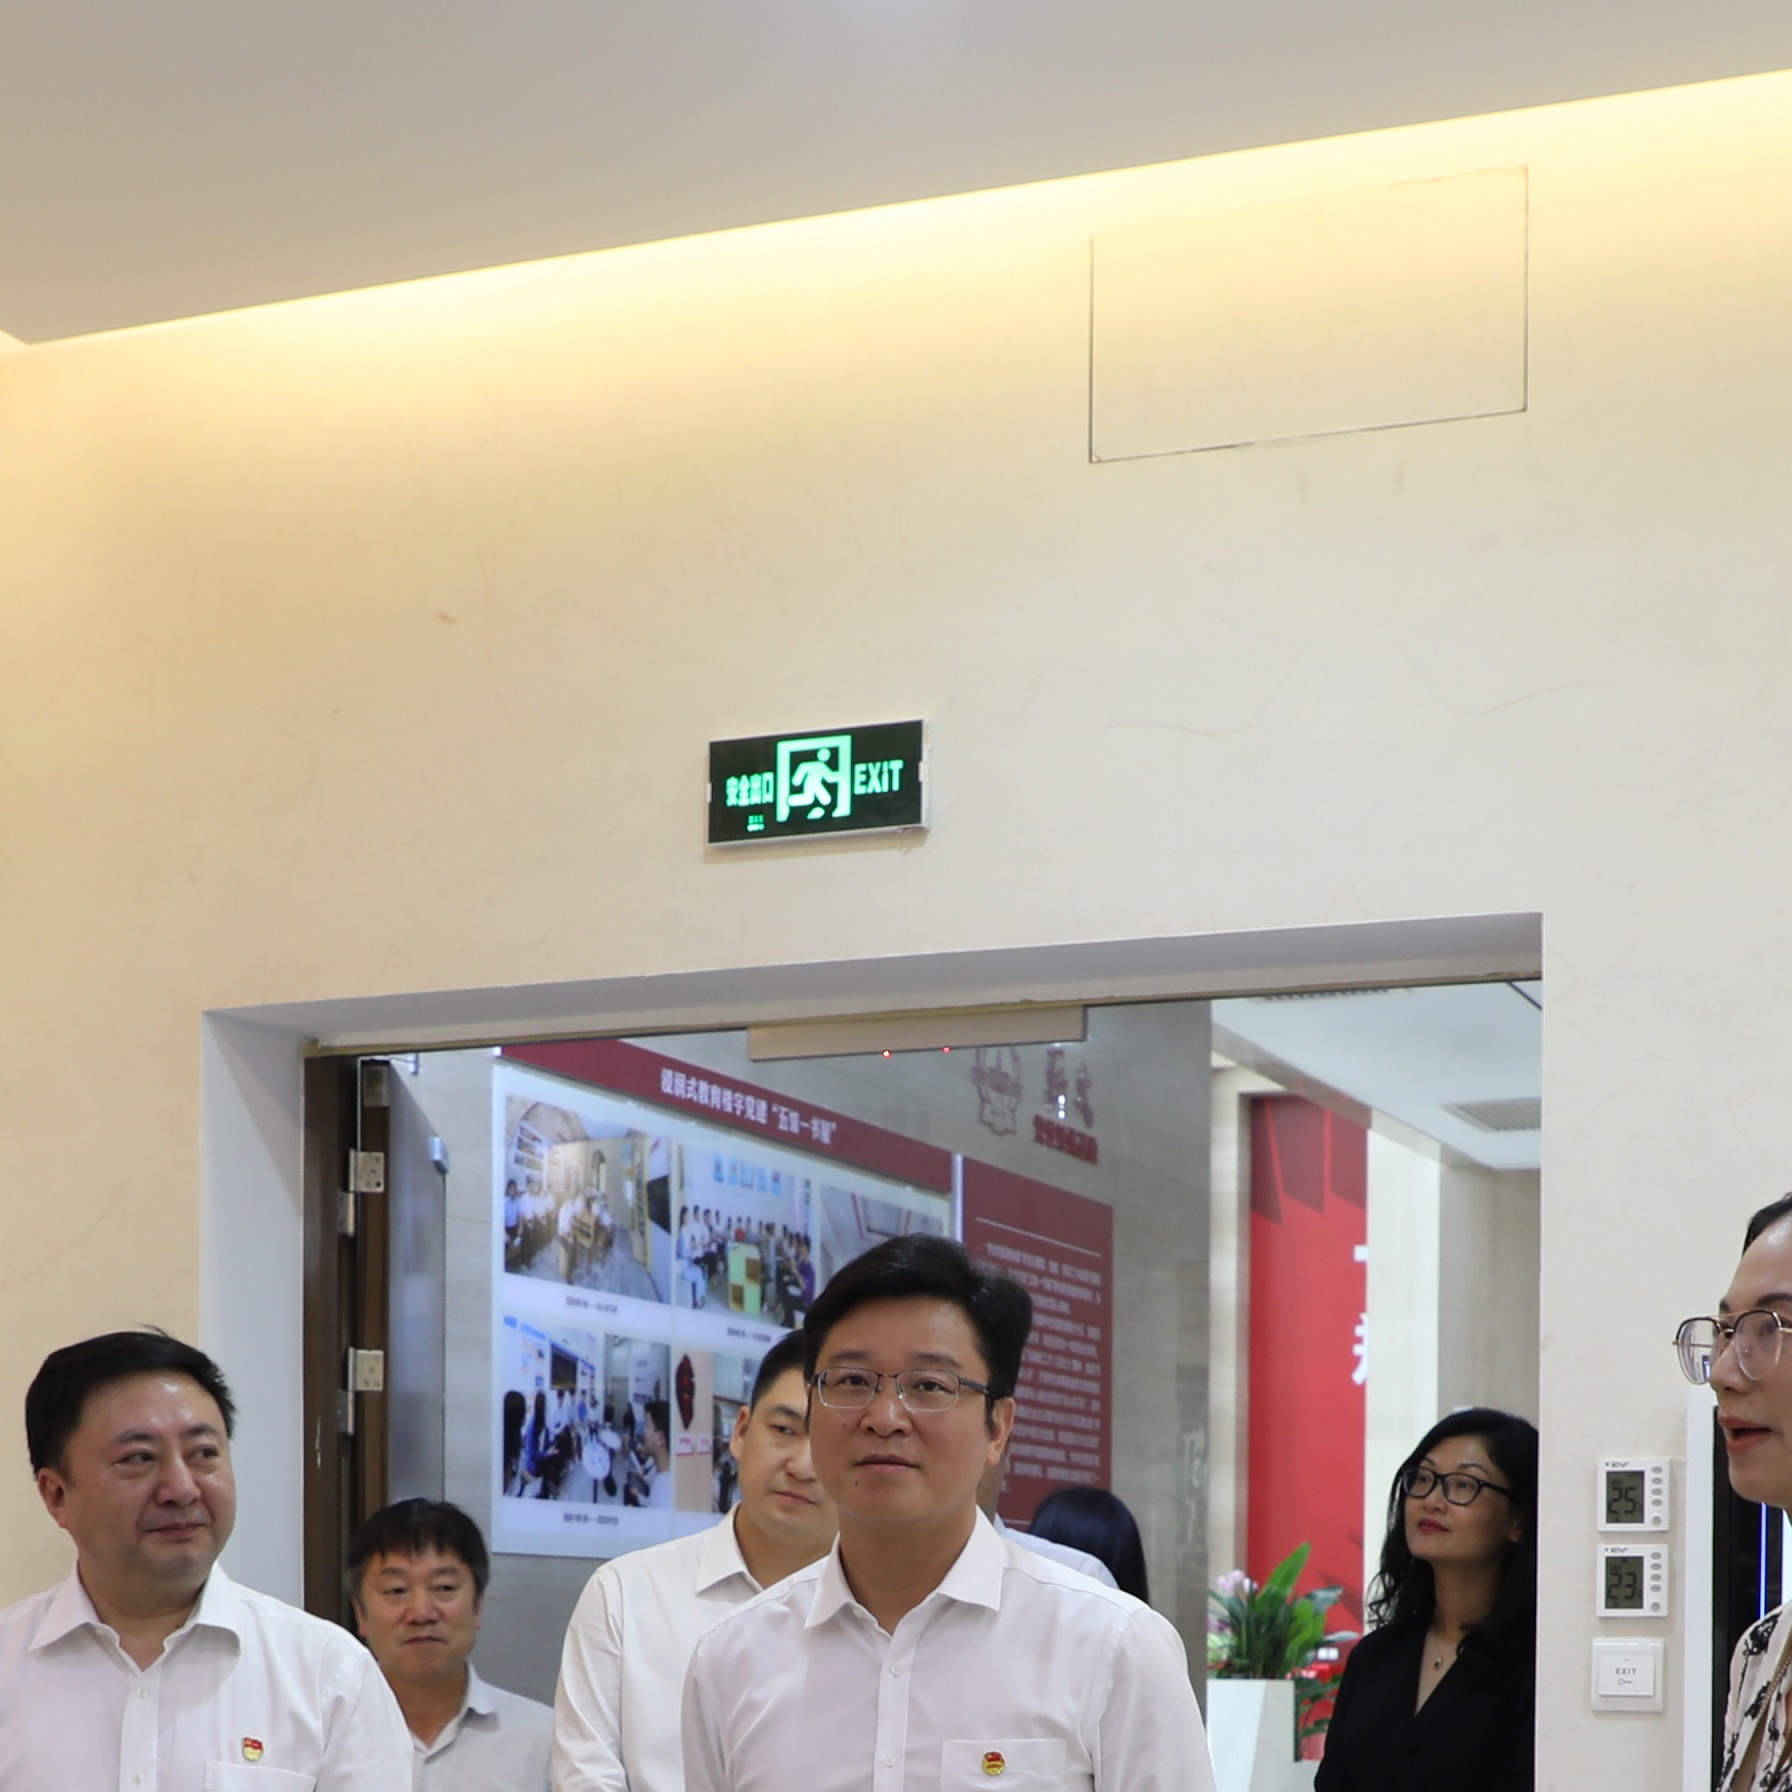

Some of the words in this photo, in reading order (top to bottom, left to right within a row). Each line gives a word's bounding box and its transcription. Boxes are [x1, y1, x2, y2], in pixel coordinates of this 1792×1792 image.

[725, 771, 774, 807] 安全出口
[854, 759, 904, 795] EXIT
[1615, 1667, 1637, 1676] EXIT
